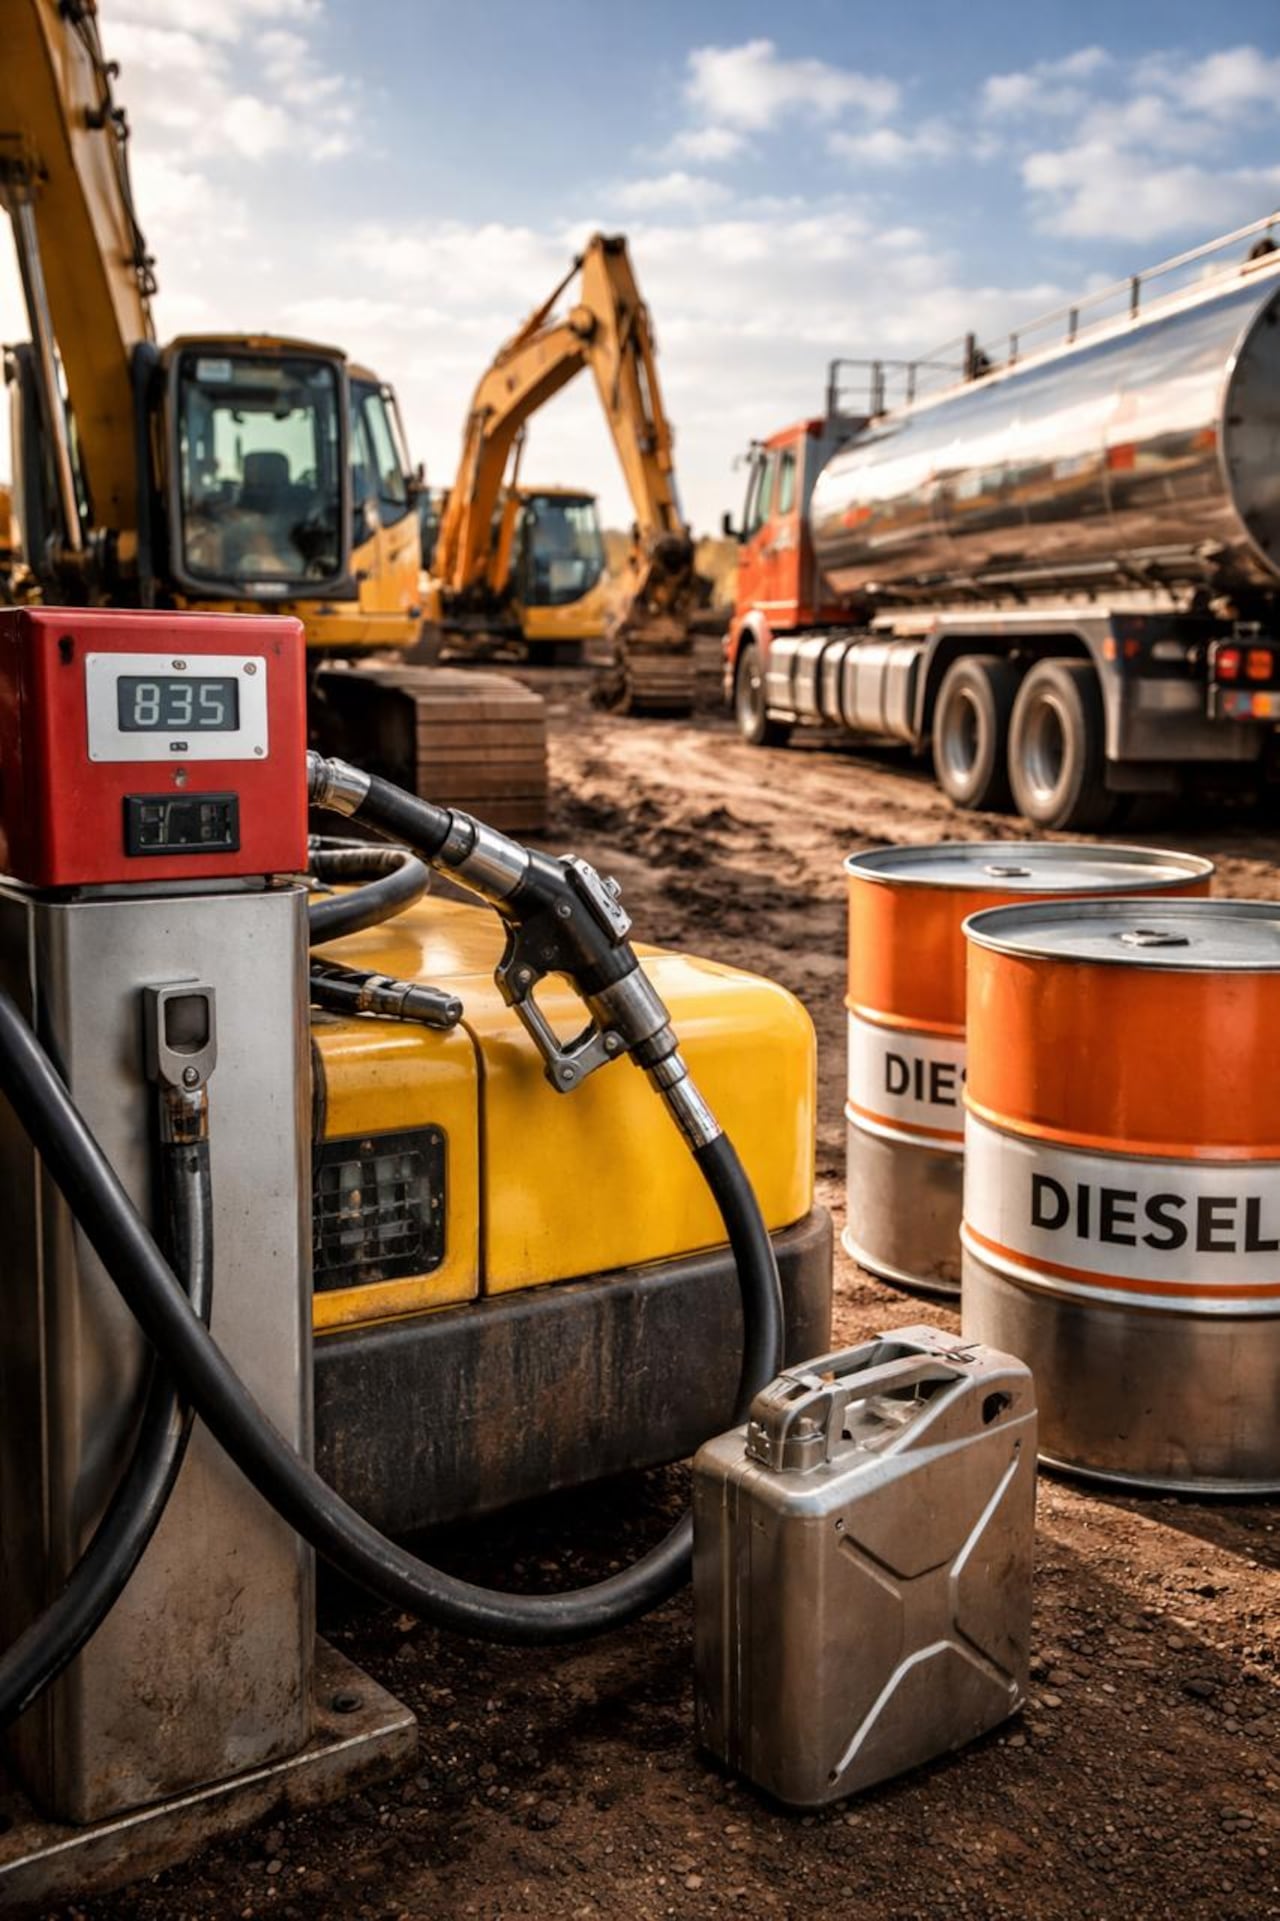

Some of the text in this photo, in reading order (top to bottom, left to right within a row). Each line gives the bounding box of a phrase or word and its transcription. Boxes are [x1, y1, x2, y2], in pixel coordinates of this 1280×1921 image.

[134, 683, 224, 725] 835
[886, 1052, 966, 1107] DIE
[1031, 1173, 1279, 1252] DIESEL
